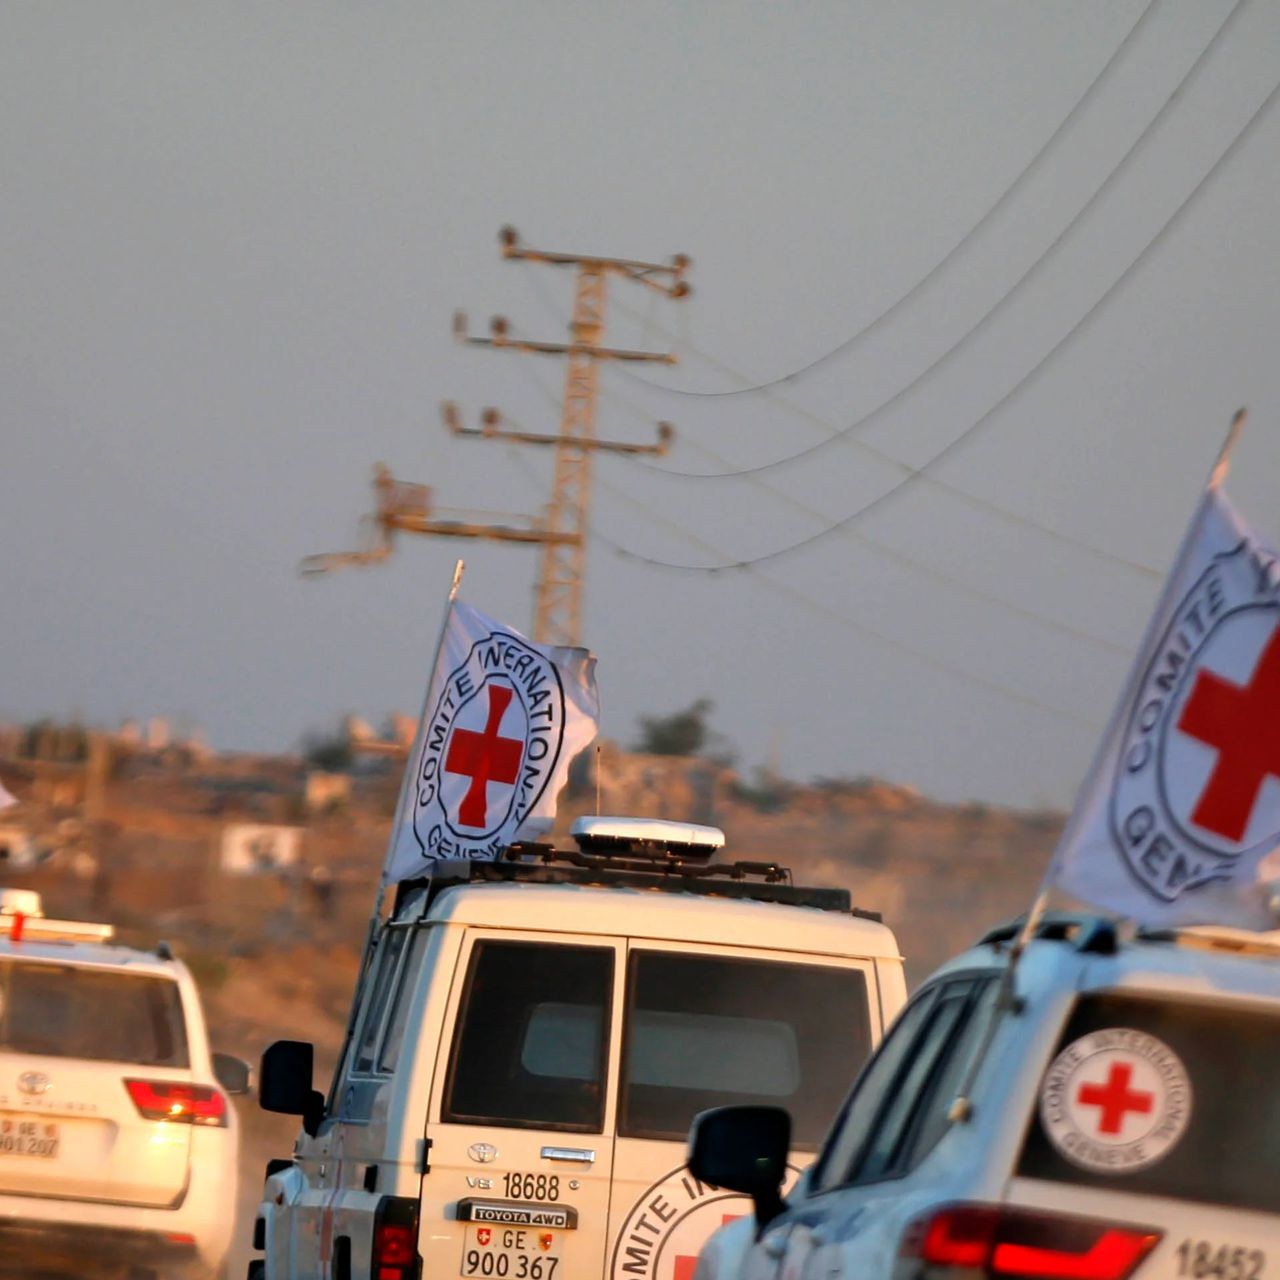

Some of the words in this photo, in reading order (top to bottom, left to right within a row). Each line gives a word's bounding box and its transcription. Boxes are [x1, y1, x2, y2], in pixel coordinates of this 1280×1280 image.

[1127, 575, 1226, 774] COMITE
[420, 671, 475, 808] COMITE
[503, 1172, 560, 1201] 18688
[477, 1210, 530, 1224] TOYOTA
[531, 1213, 565, 1226] 4WD
[503, 1230, 526, 1250] GE
[467, 1249, 509, 1277] 900
[515, 1254, 559, 1280] 367
